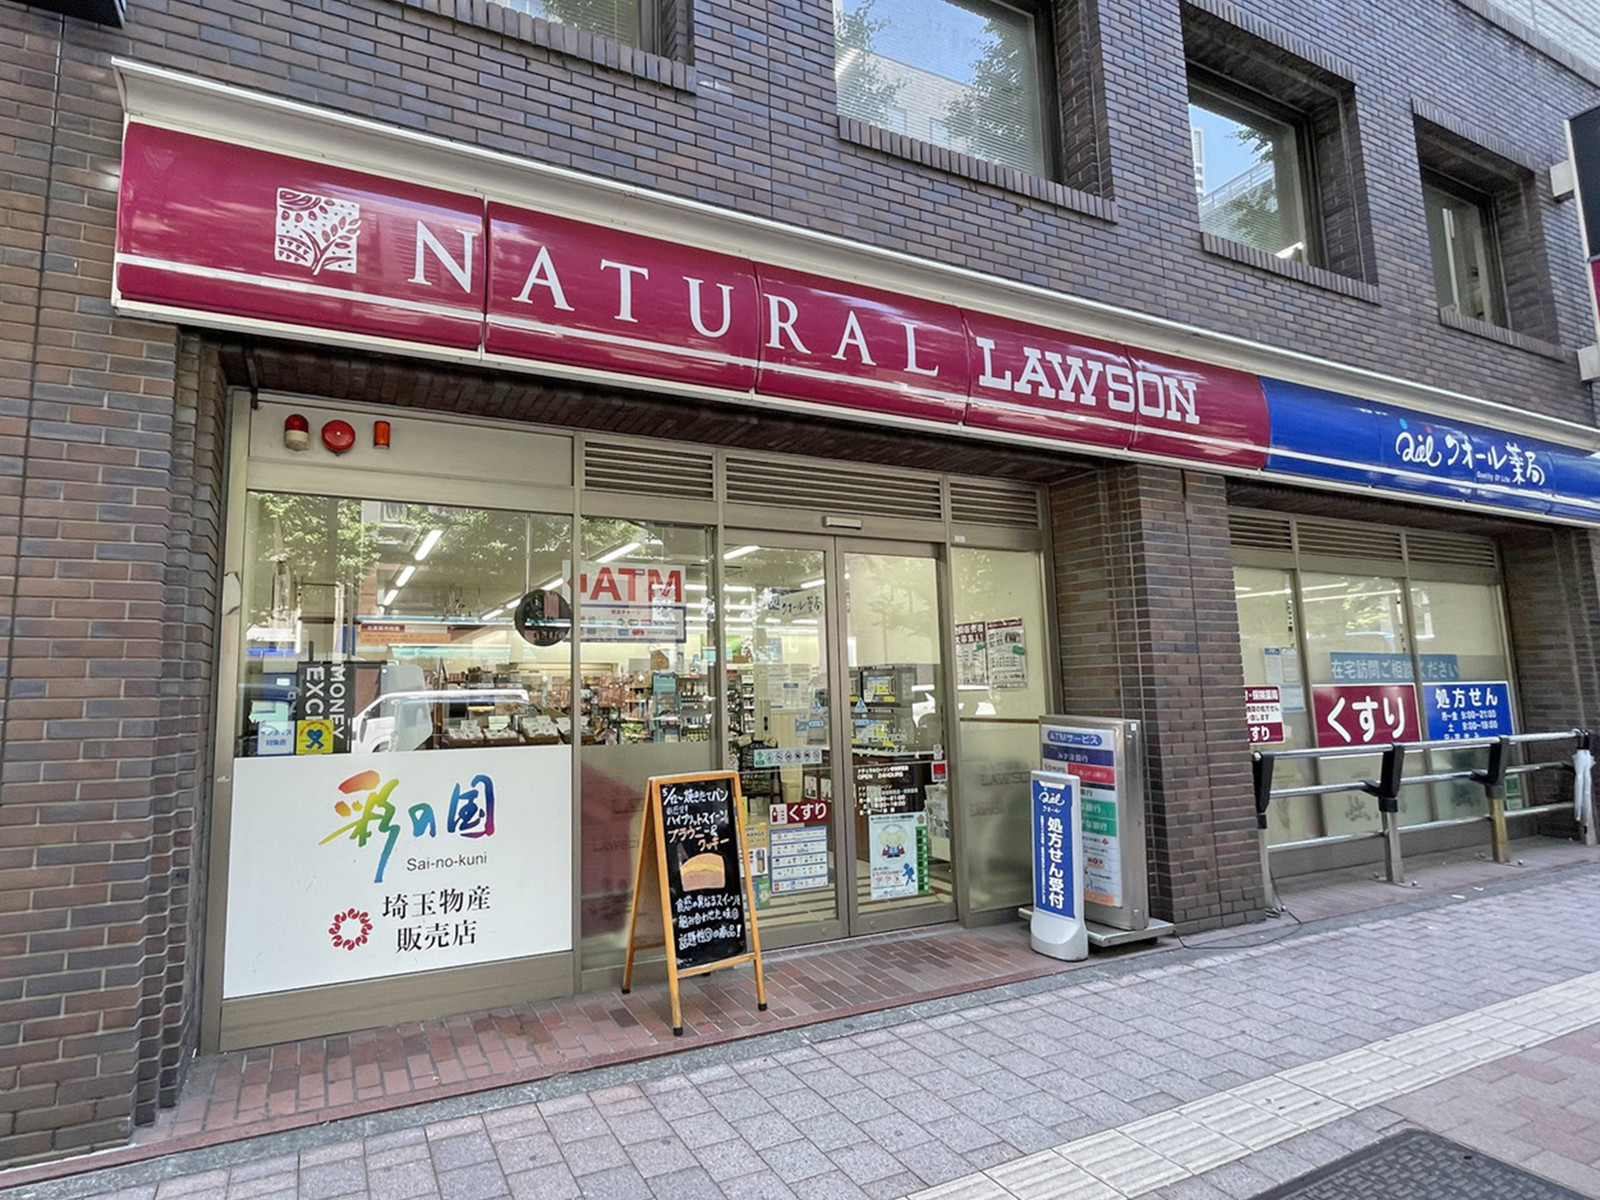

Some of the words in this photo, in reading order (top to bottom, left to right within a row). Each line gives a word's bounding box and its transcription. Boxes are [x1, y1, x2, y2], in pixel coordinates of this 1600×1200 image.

[406, 220, 940, 377] NATURAL
[976, 336, 1200, 425] LAWSON
[1445, 434, 1545, 486] クオール薬局
[589, 567, 682, 603] ATM
[305, 665, 325, 720] EXC
[329, 664, 346, 740] MONEY
[1435, 687, 1498, 709] 処方せん
[1246, 725, 1270, 742] すり
[1327, 696, 1406, 742] くすり
[318, 770, 495, 883] 彩の国
[788, 803, 827, 821] くすり
[406, 851, 488, 871] Sai-no-kuni
[1047, 816, 1064, 909] 処方せん受付
[382, 885, 491, 919] 埼玉物産
[396, 919, 478, 953] 販売店
